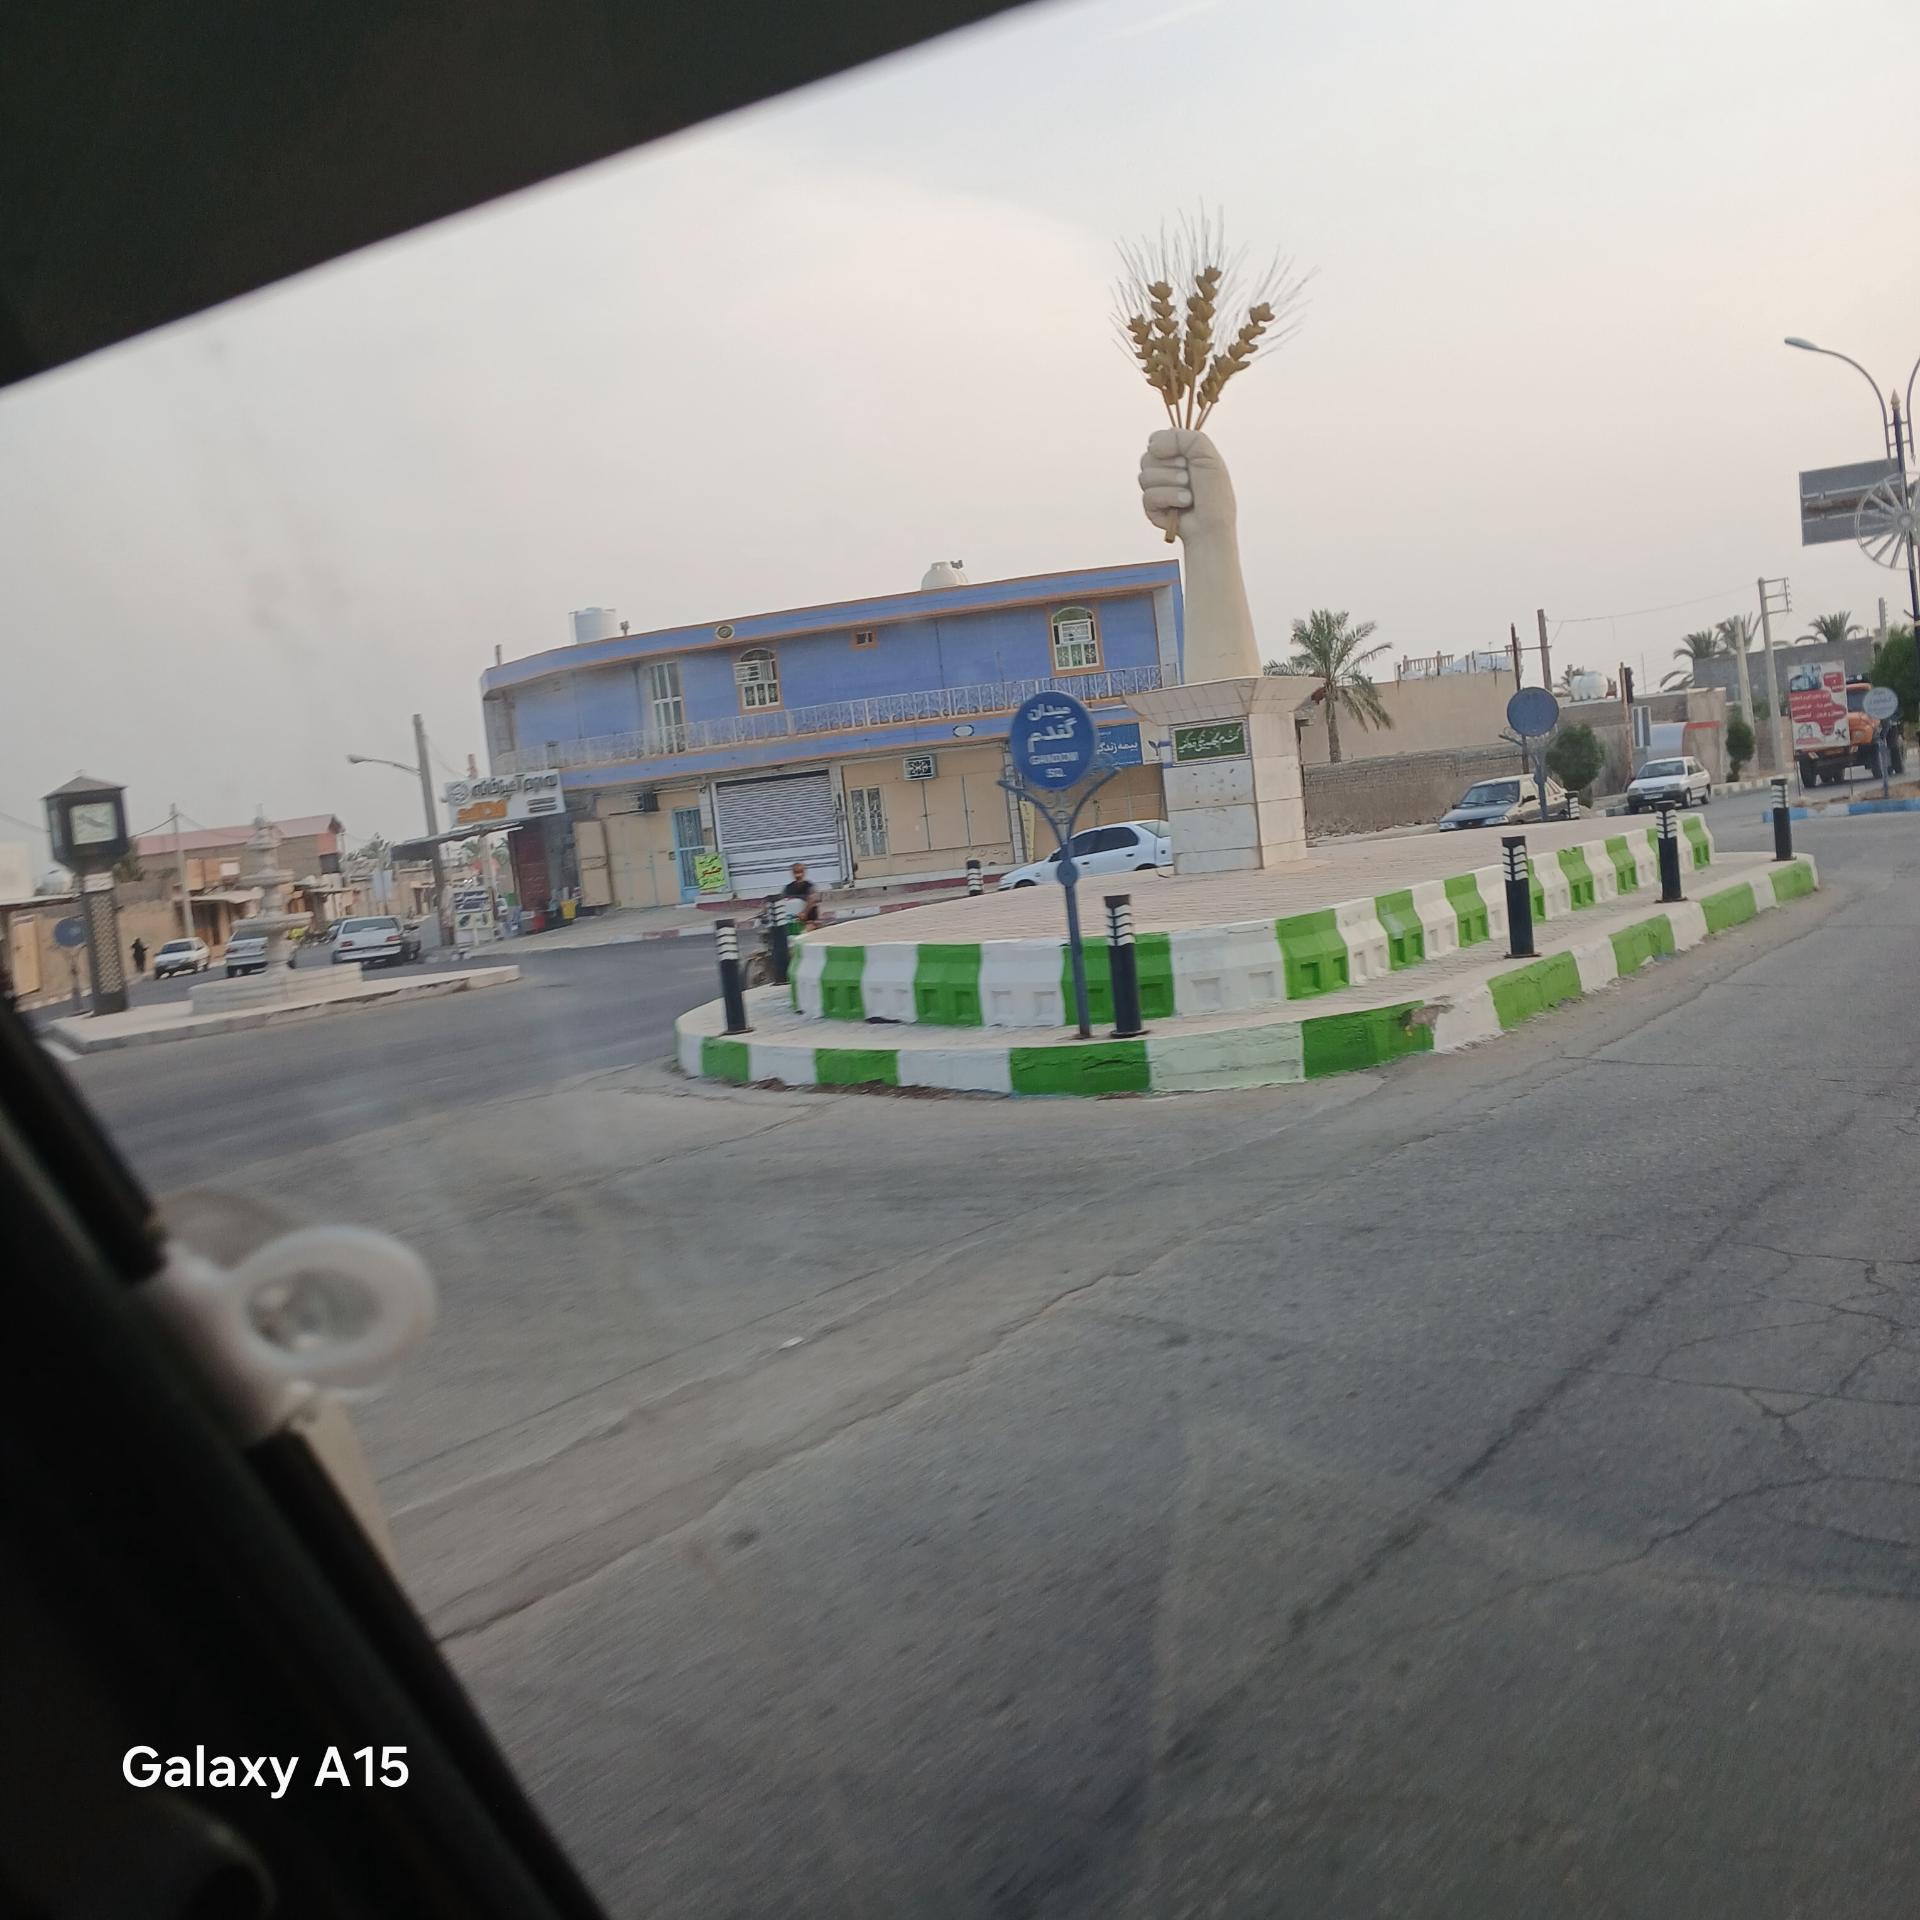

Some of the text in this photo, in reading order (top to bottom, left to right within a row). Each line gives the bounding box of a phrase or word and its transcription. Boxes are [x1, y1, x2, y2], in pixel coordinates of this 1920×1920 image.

[1027, 703, 1072, 720] میدان
[1027, 716, 1077, 752] گندم
[1118, 741, 1139, 752] بیمه
